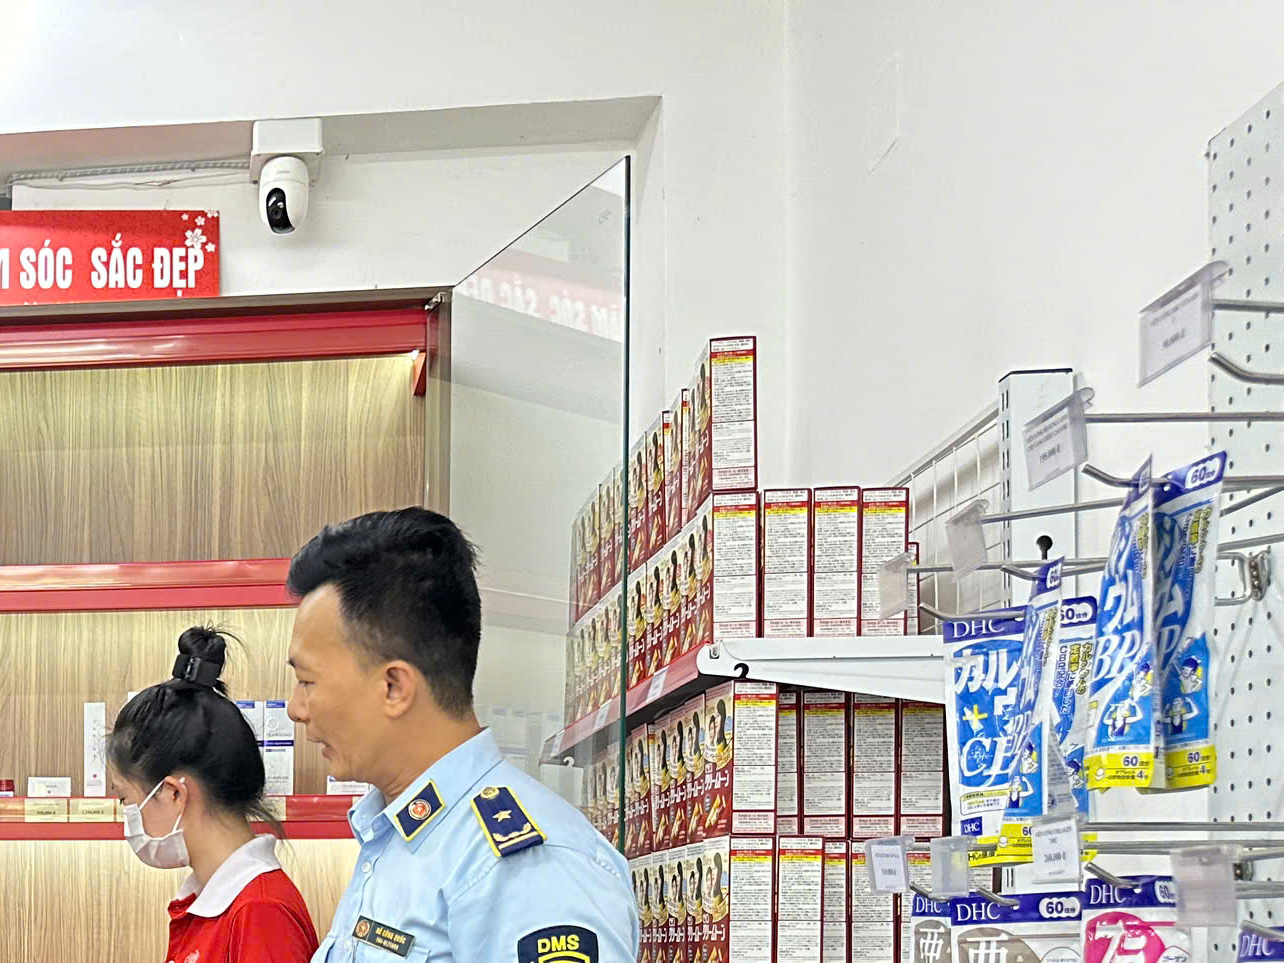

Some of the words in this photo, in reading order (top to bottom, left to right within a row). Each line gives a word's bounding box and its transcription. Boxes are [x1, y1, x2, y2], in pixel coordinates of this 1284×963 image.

[19, 239, 73, 288] SÓC
[90, 233, 143, 288] SẮC
[152, 248, 204, 296] ĐẸP
[952, 619, 1005, 638] DHC
[956, 902, 1001, 922] DHC
[537, 934, 580, 954] DMS
